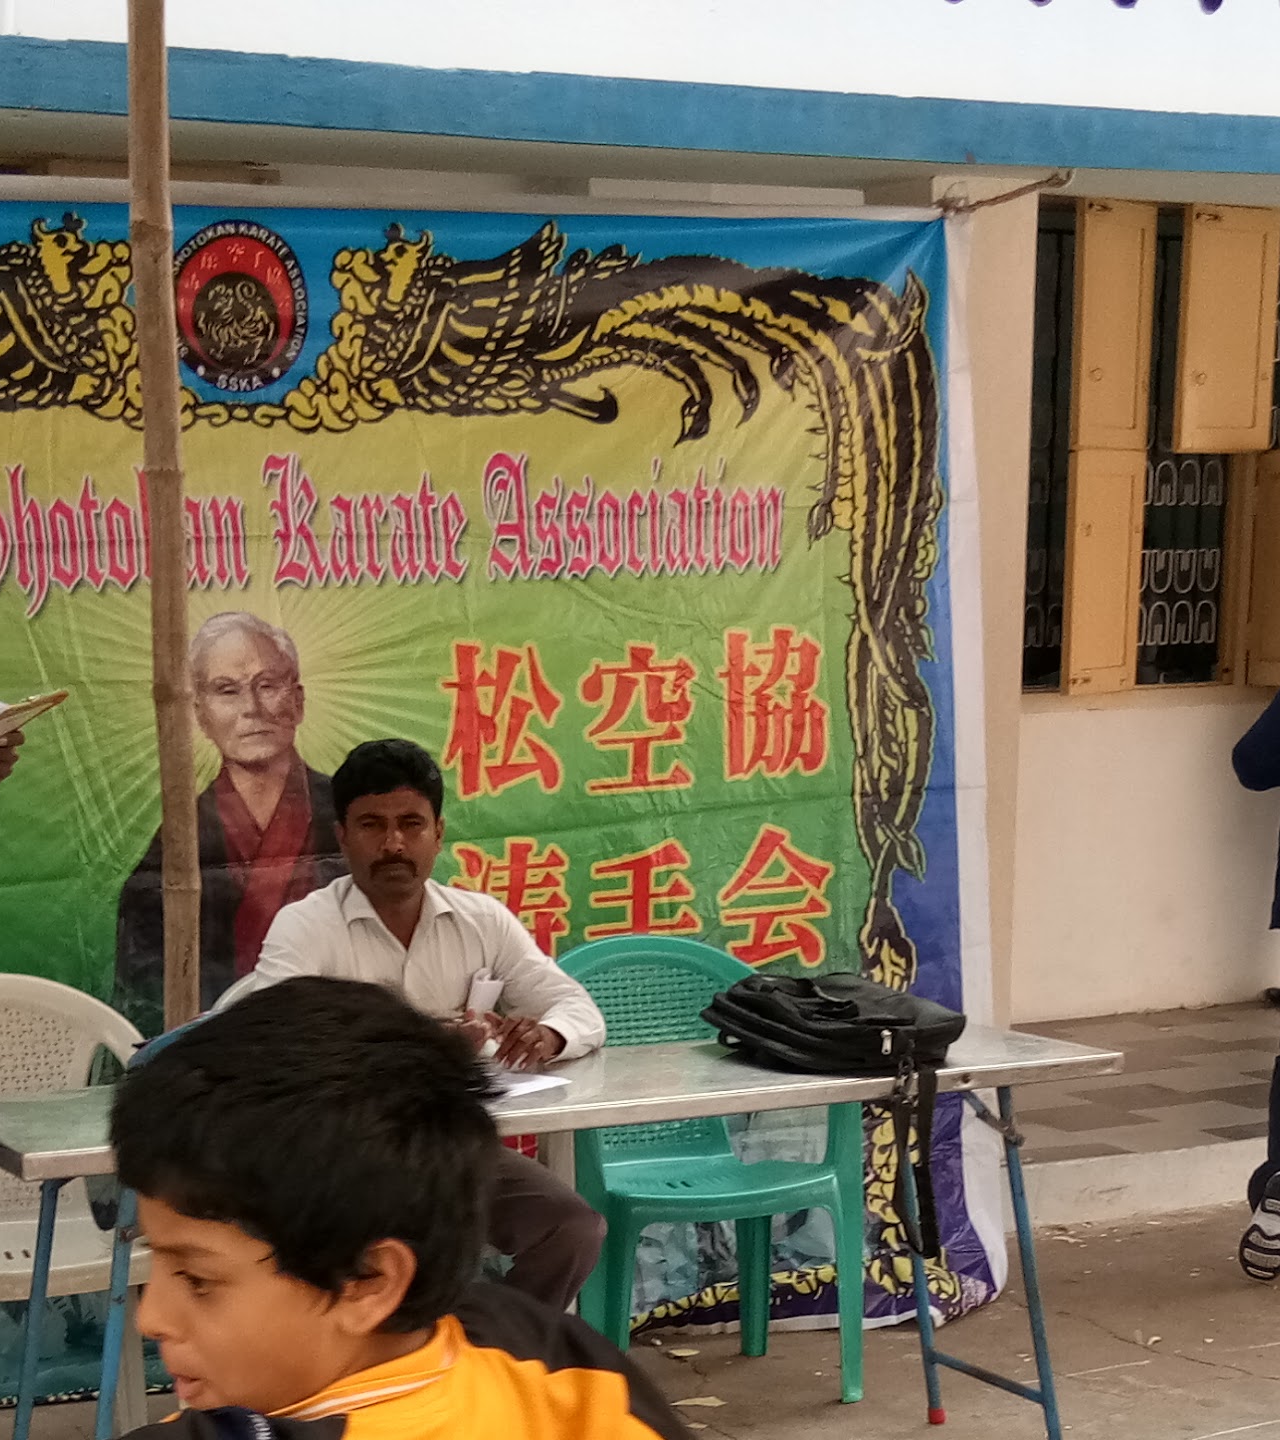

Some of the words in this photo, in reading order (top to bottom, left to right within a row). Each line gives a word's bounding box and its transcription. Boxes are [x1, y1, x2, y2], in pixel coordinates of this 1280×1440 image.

[238, 223, 289, 258] KARATE
[216, 374, 264, 392] SSKA
[262, 451, 471, 588] Karate
[483, 451, 785, 580] Association
